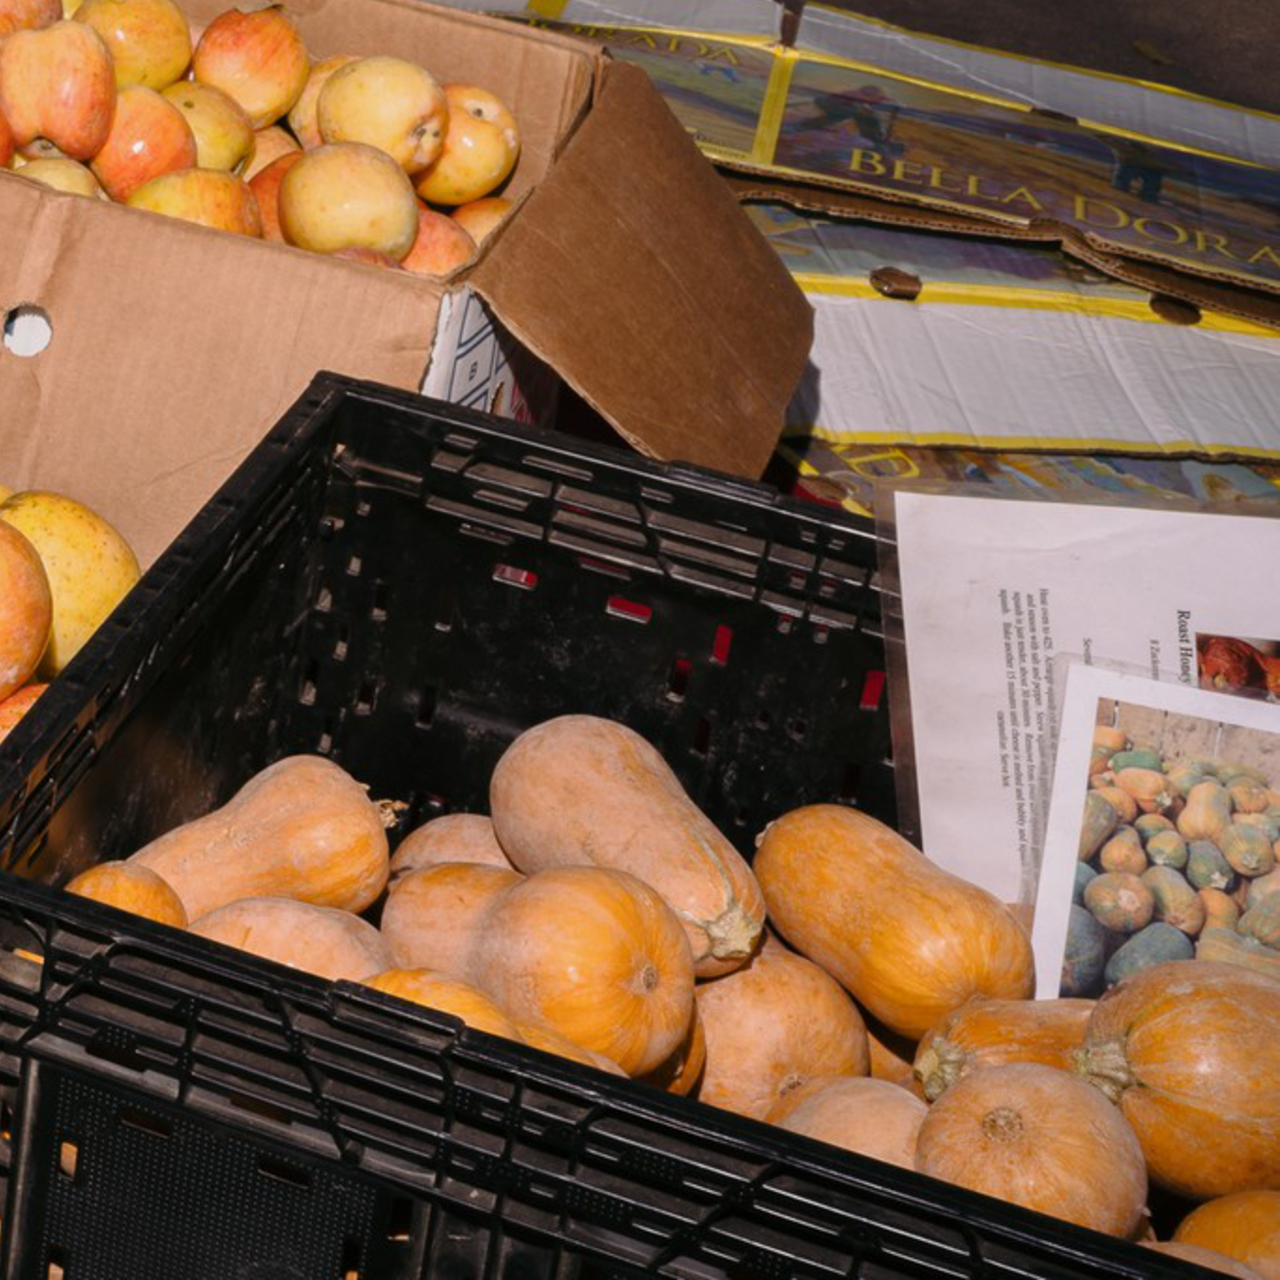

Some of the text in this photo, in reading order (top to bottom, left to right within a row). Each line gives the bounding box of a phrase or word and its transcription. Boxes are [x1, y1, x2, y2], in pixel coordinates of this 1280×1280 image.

[849, 148, 1046, 211] BELLA
[1177, 610, 1193, 683] Roast Honey
